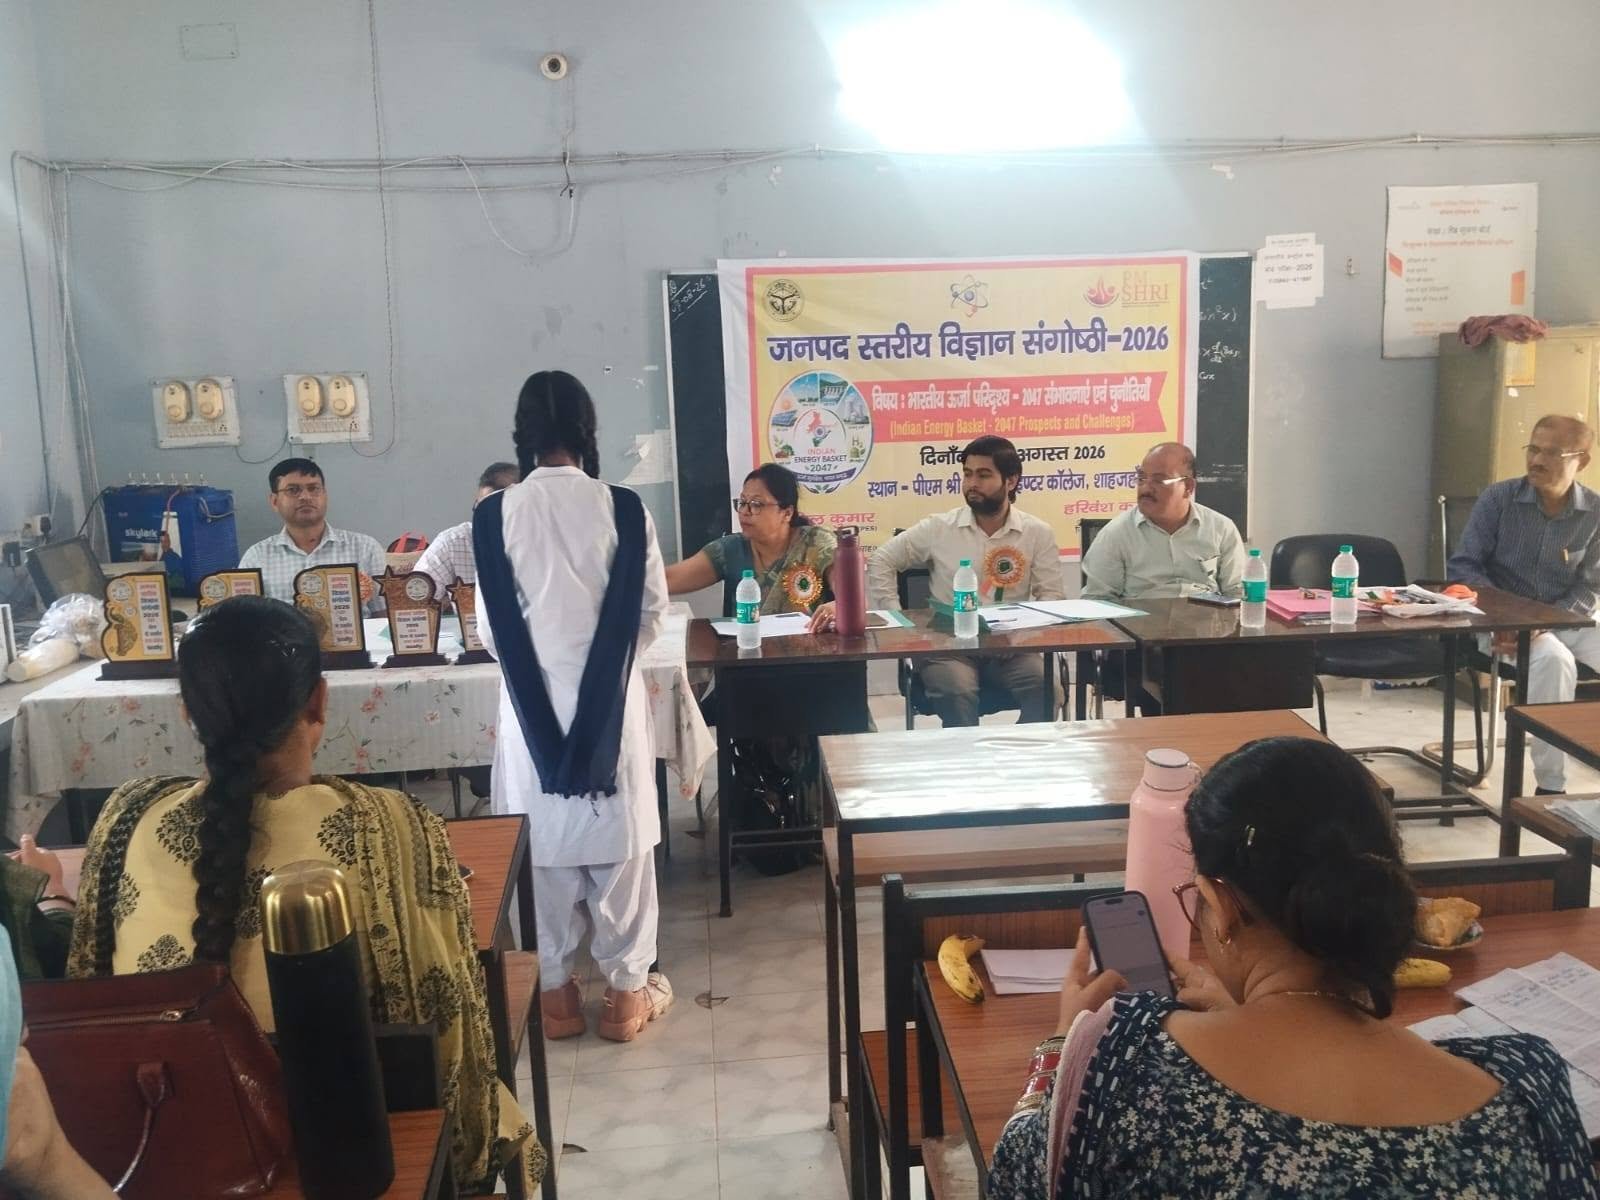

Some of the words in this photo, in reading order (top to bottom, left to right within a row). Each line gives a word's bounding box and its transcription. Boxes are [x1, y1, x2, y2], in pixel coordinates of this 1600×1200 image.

[1121, 284, 1168, 301] SHRI
[766, 335, 851, 362] जनपद
[857, 322, 932, 361] स्तरीय
[938, 321, 1016, 361] विज्ञान
[871, 384, 898, 411] विषय
[907, 383, 945, 410] भारतीय
[947, 382, 971, 409] ऊर्जा
[1022, 387, 1042, 406] 2047
[890, 420, 921, 439] (Indian
[923, 419, 954, 438] Energy
[956, 417, 986, 434] Basket
[994, 416, 1017, 432] 2047
[1018, 415, 1062, 433] Prospects
[1064, 414, 1080, 430] and
[1082, 412, 1135, 431] Challenges)
[822, 454, 848, 462] BASKET
[1017, 446, 1069, 462] अगस्त
[1074, 445, 1106, 460] 2026
[810, 464, 832, 472] 2047
[867, 481, 898, 498] स्थान
[912, 473, 943, 497] पीएम
[946, 472, 961, 495] श्री
[830, 512, 875, 527] कुमार
[125, 528, 158, 539] skylark
